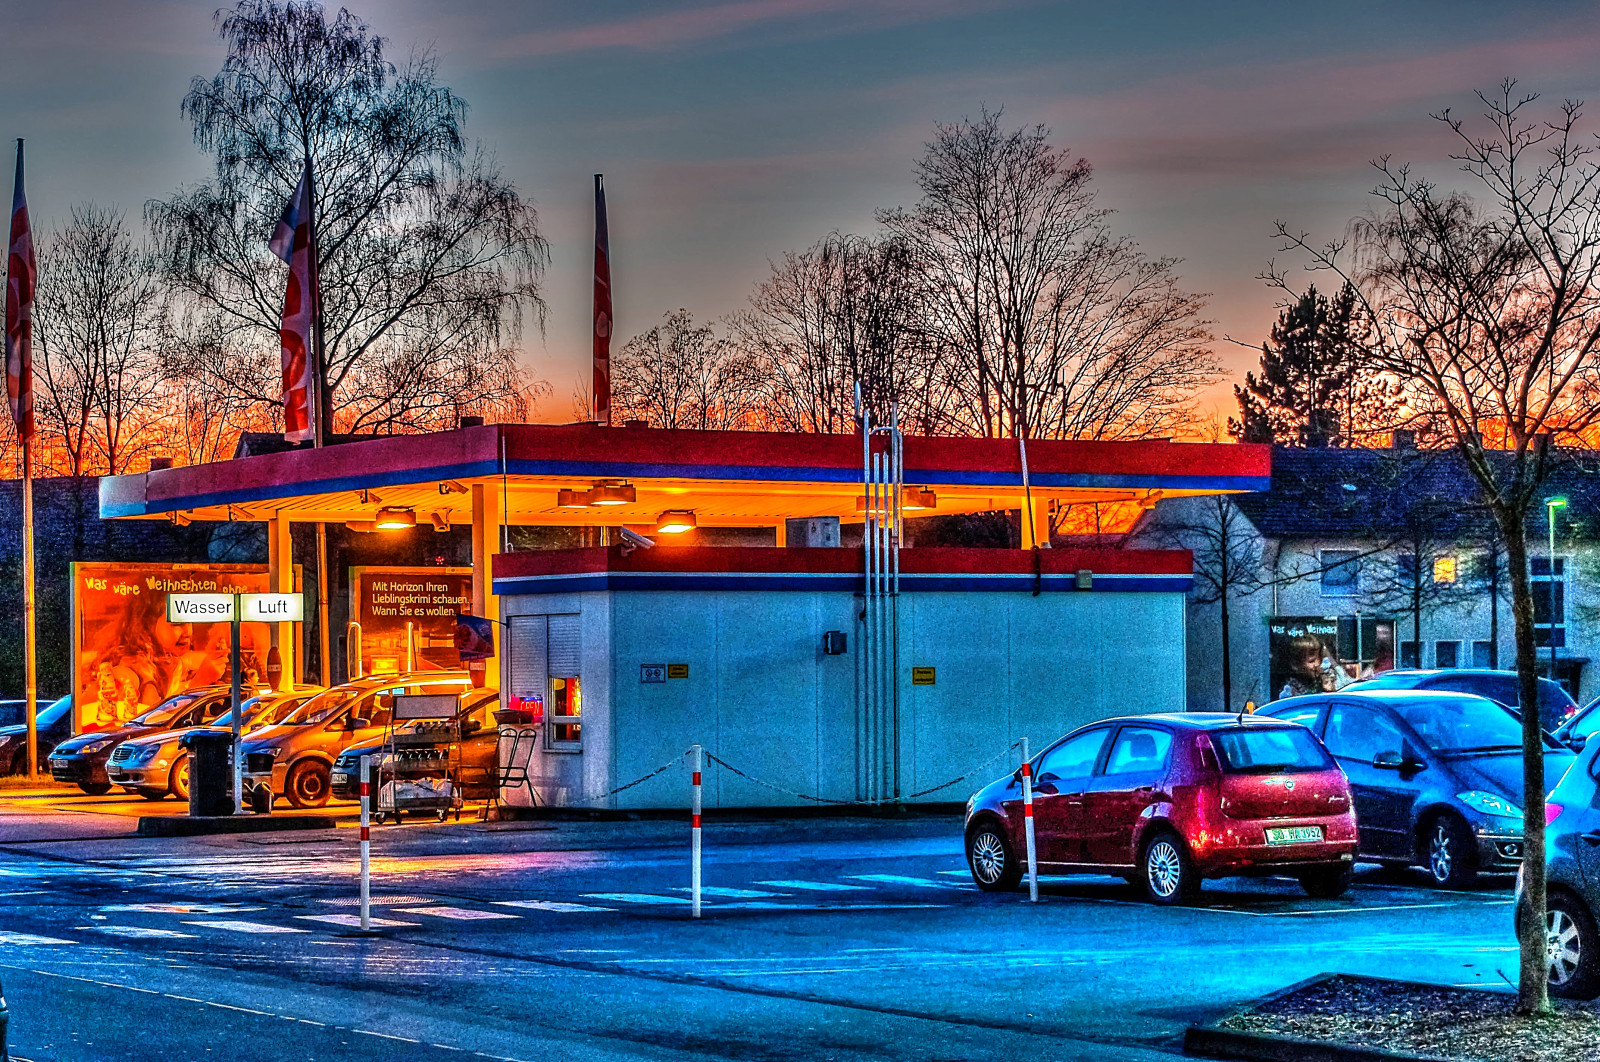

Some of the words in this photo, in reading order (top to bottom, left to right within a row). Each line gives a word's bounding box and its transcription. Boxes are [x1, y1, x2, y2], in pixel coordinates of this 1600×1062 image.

[85, 577, 107, 591] Was
[113, 581, 141, 596] wäre
[146, 576, 217, 592] Weihnachten
[222, 584, 247, 594] ohne
[372, 581, 388, 592] Mit
[390, 581, 424, 592] Horizon
[425, 581, 448, 592] Ihren
[372, 594, 430, 605] Lieblingskrimi
[432, 593, 470, 604] schauen.
[174, 600, 232, 614] Wasser
[258, 599, 288, 614] Luft
[372, 606, 397, 615] Wann
[399, 605, 413, 616] Sie
[414, 607, 425, 616] es
[425, 605, 457, 616] wollen.
